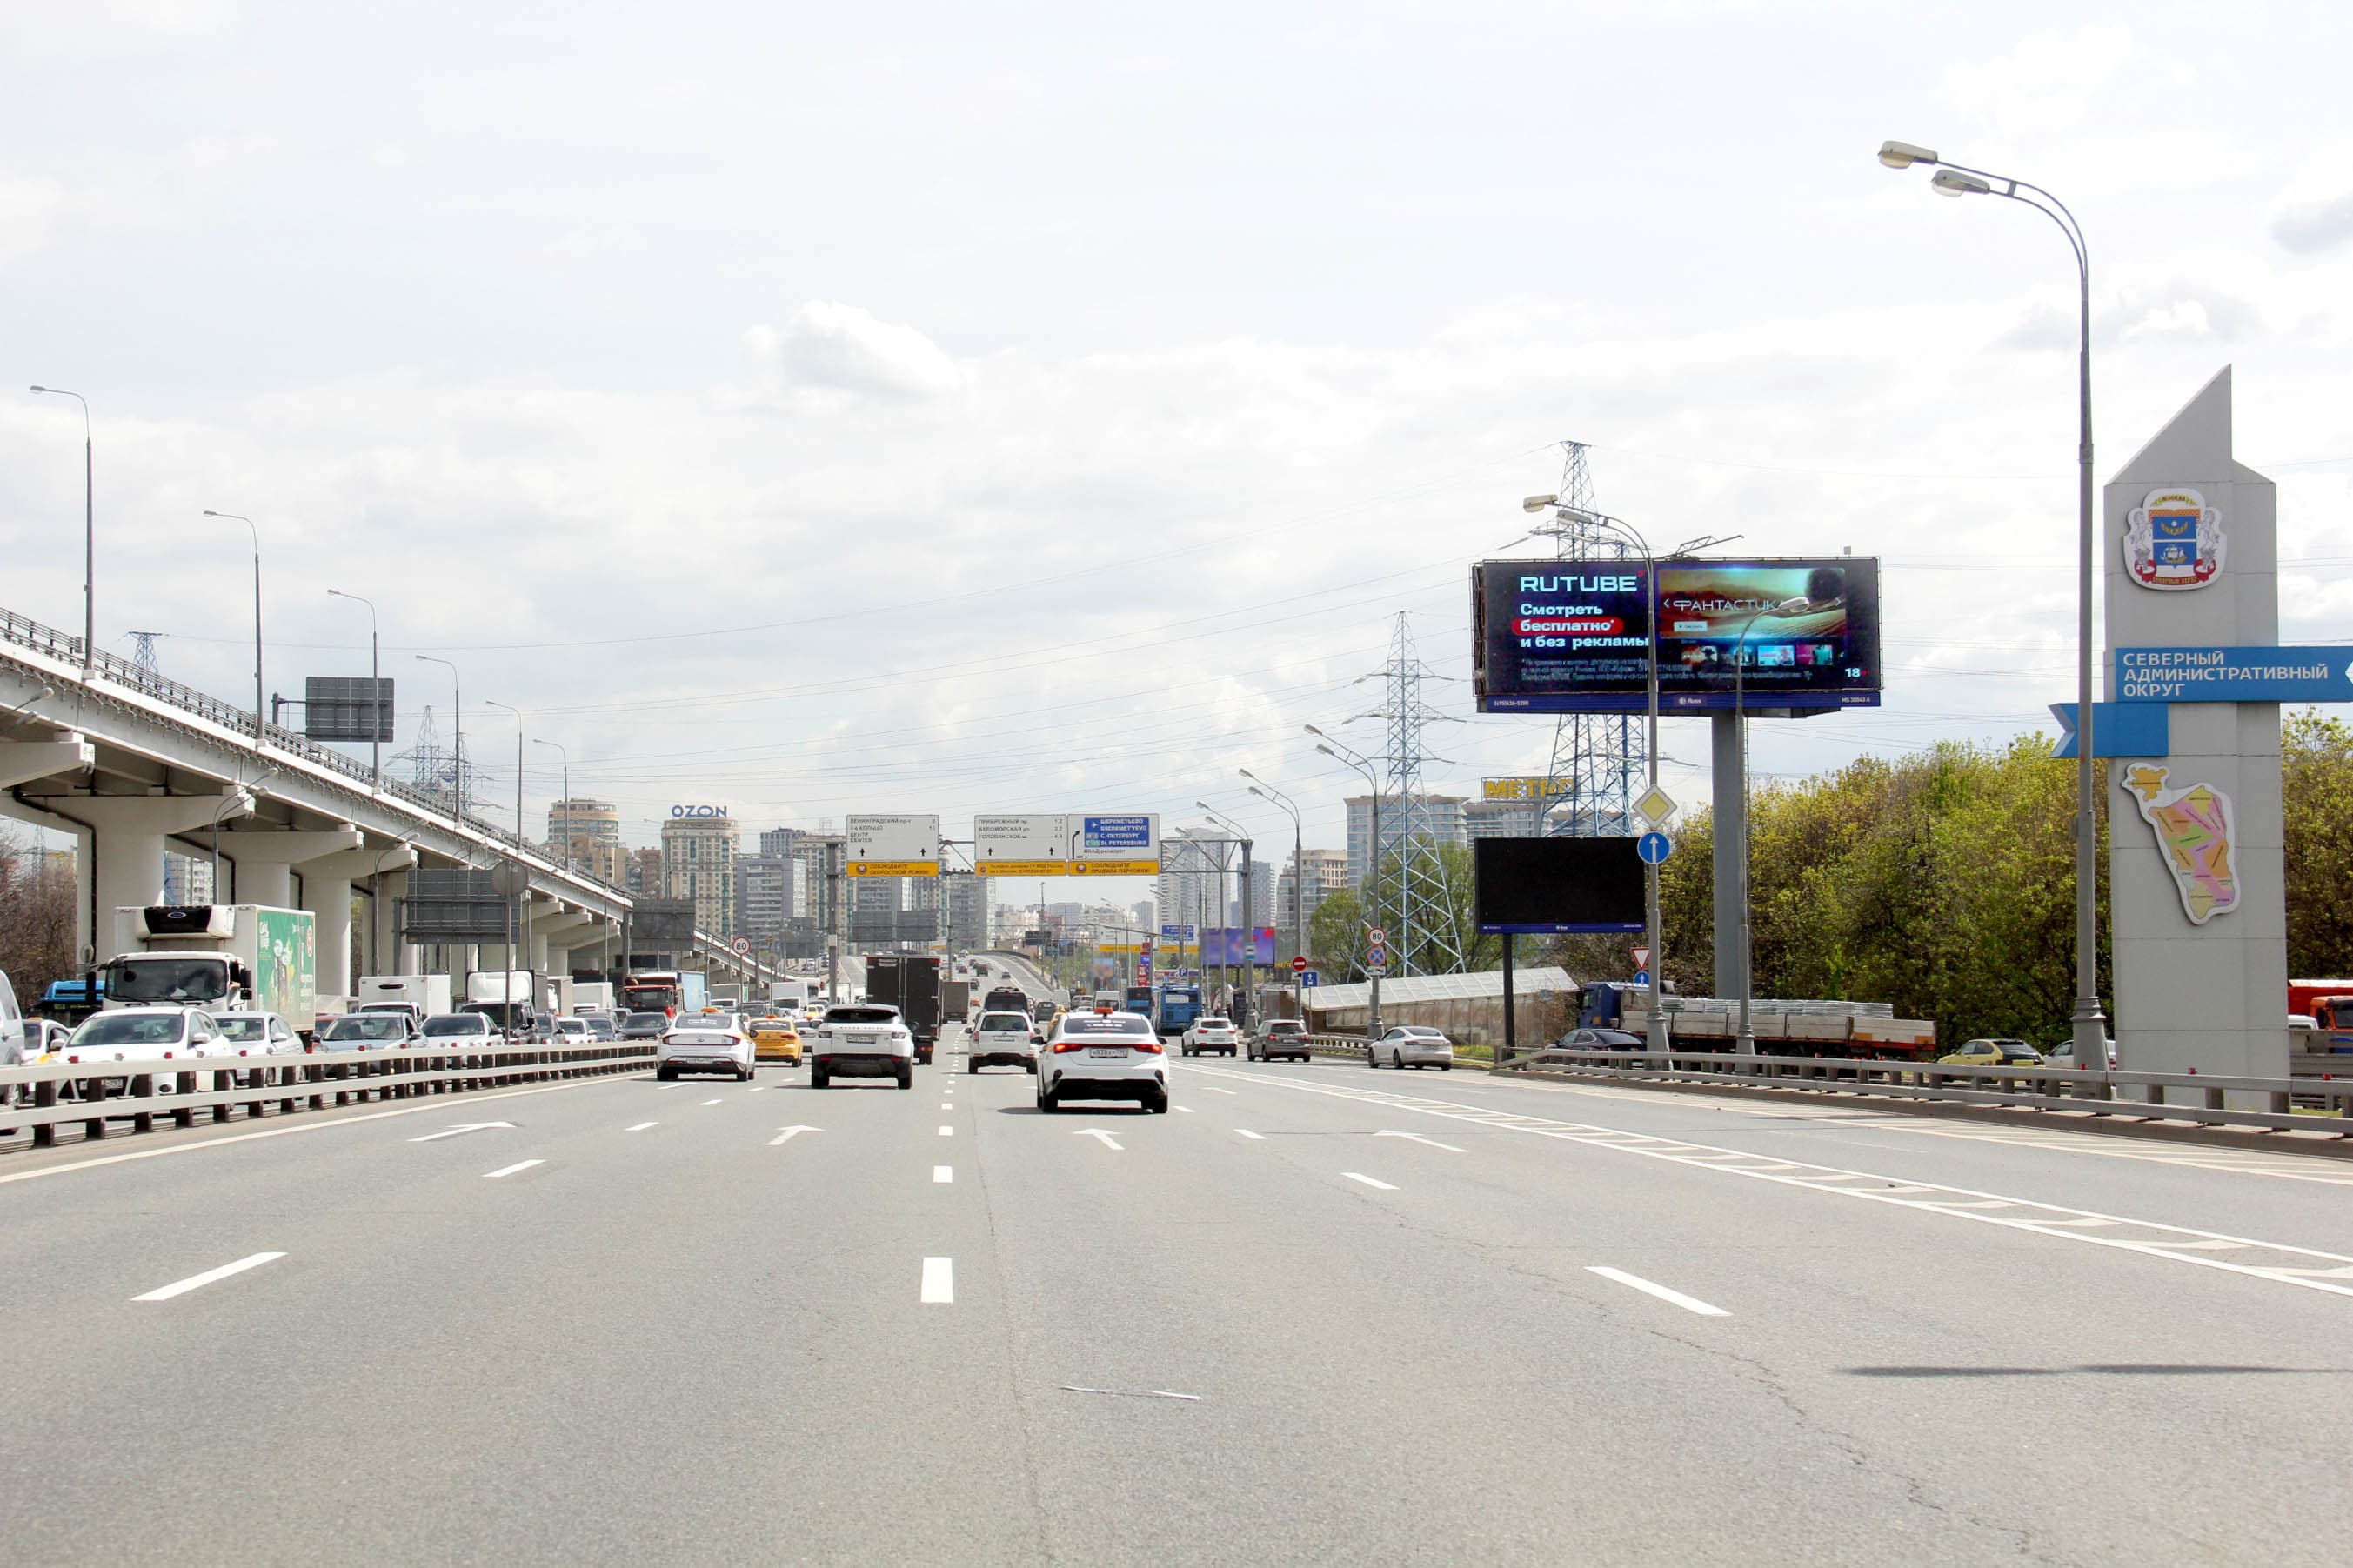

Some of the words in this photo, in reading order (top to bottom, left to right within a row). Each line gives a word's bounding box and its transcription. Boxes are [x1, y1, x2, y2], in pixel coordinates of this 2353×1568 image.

[1520, 576, 1637, 592] RUTUBE
[1520, 604, 1603, 617] Смотреть
[1673, 598, 1786, 611] ФАНТАСТИК
[1521, 638, 1531, 647] и
[1535, 635, 1565, 648] без
[1573, 637, 1649, 650] рекламы
[2122, 651, 2224, 666] СЕВЕРНЫЙ
[2124, 664, 2329, 682] АДМИНИСТРАТИВНЫЙ
[2123, 684, 2185, 697] ОКРУГ
[672, 805, 727, 817] OZON
